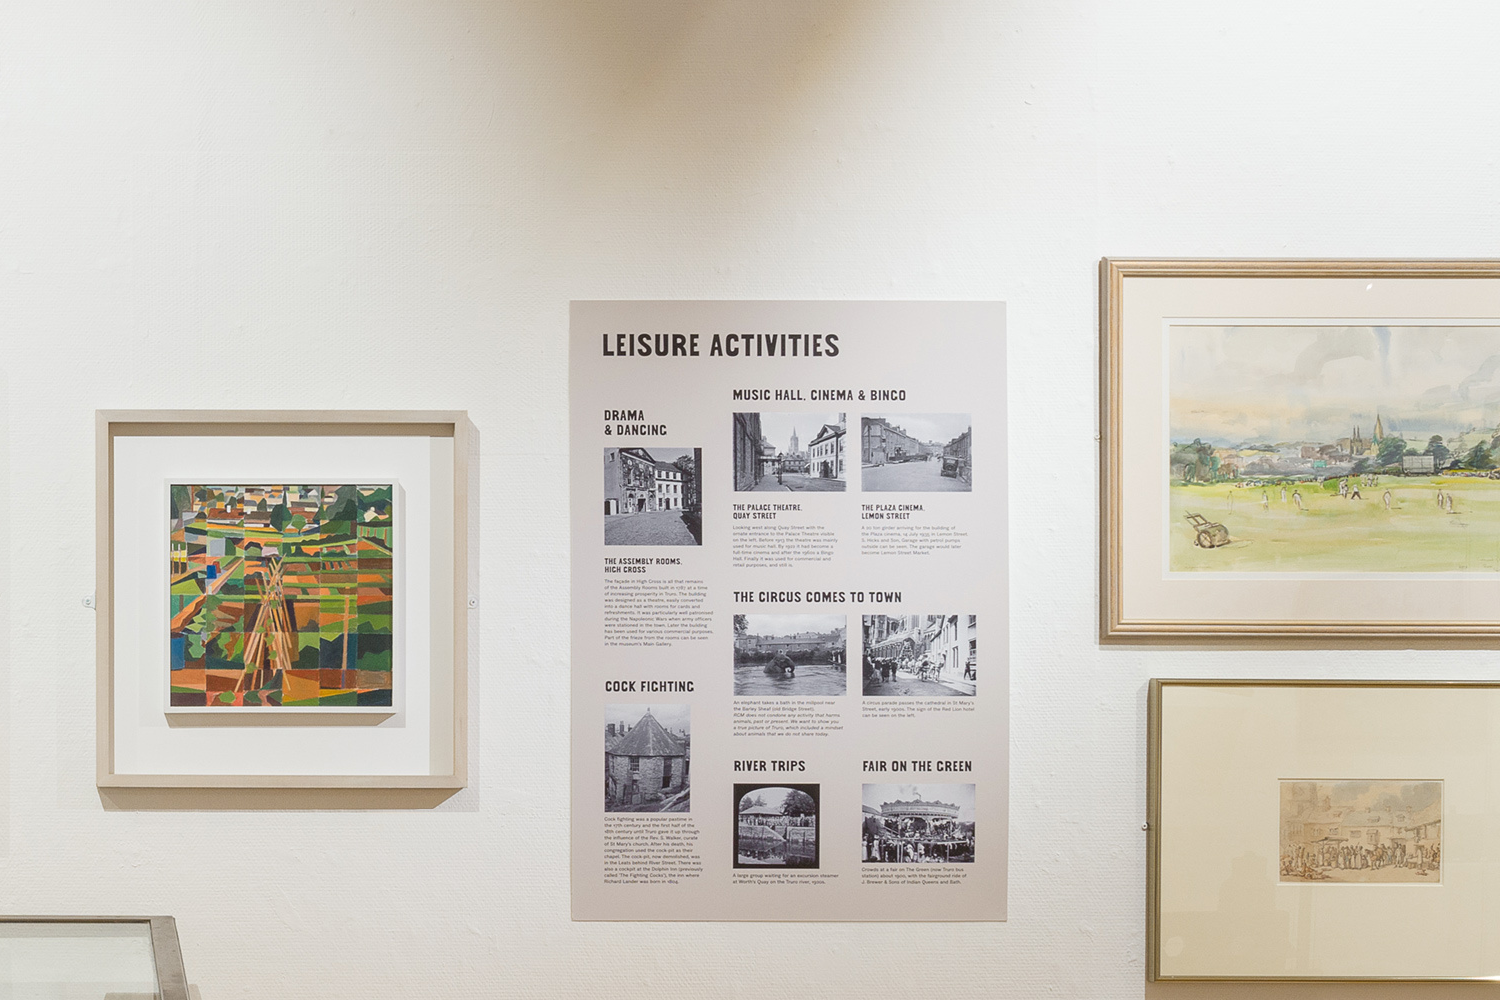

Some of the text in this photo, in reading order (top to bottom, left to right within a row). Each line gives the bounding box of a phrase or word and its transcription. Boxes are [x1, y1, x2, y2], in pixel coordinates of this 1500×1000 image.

[602, 333, 840, 357] LEISURE ACTIVITIES
[733, 389, 770, 401] MUSIC
[811, 389, 853, 401] CINEMA
[858, 389, 865, 401] &
[870, 389, 906, 401] BINGO
[604, 410, 645, 421] DRAMA
[604, 424, 667, 436] & DANCING
[733, 591, 902, 603] THE CIRCUS COMES TO TOWN
[605, 681, 694, 692] COCK FIGHTING
[733, 760, 806, 772] RIVER TRIPS
[862, 760, 972, 772] FAIR ON THE GREEN
